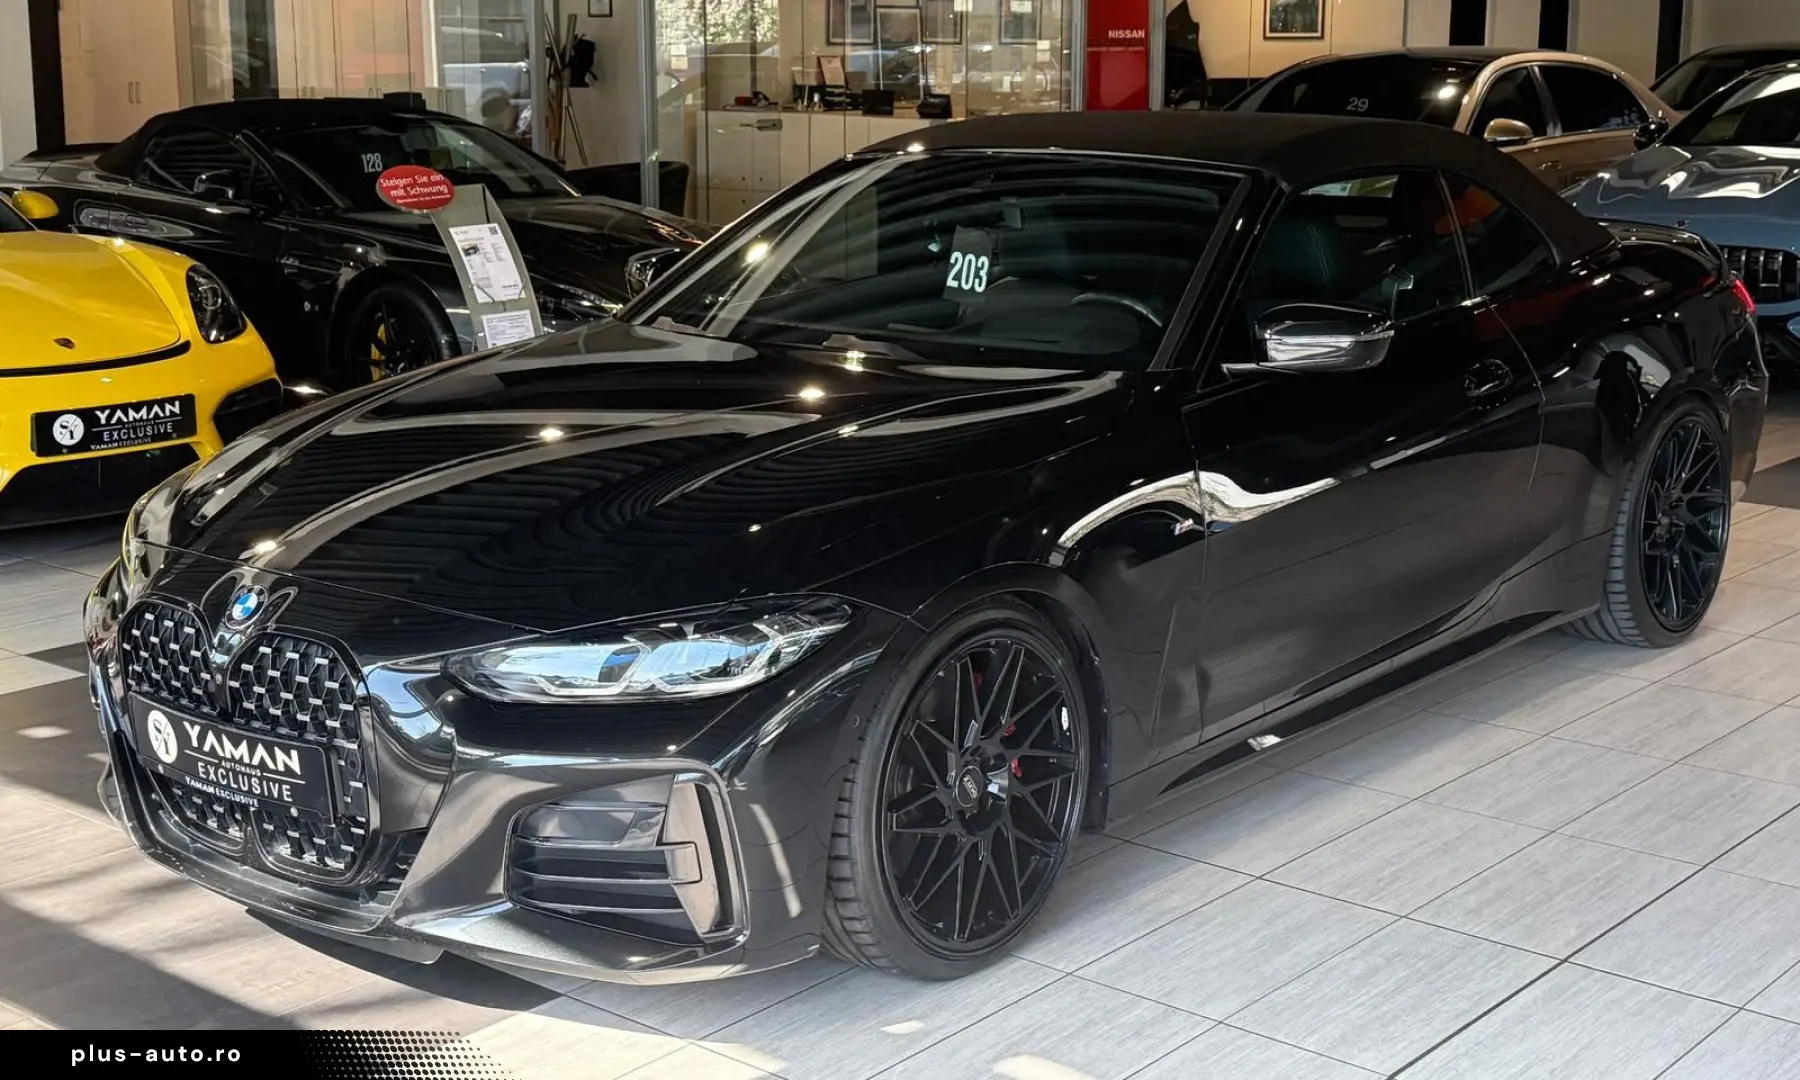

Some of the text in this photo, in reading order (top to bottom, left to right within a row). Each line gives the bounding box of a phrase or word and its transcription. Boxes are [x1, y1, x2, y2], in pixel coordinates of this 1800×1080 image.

[1108, 29, 1145, 38] NISSAN
[1346, 97, 1369, 111] 29
[361, 152, 383, 173] 128
[380, 173, 444, 188] Steigen Sie ein
[390, 184, 448, 197] mit Schwung
[946, 251, 989, 293] 203
[95, 400, 181, 425] YAMAN
[103, 422, 173, 442] EXCLUSIVE
[90, 442, 118, 450] YAMAN
[182, 721, 301, 775] YAMAN
[221, 761, 261, 776] AUTOHAUS
[184, 776, 259, 807] YAMAN EXCLUSIVE
[197, 762, 293, 802] EXCLUSIVE
